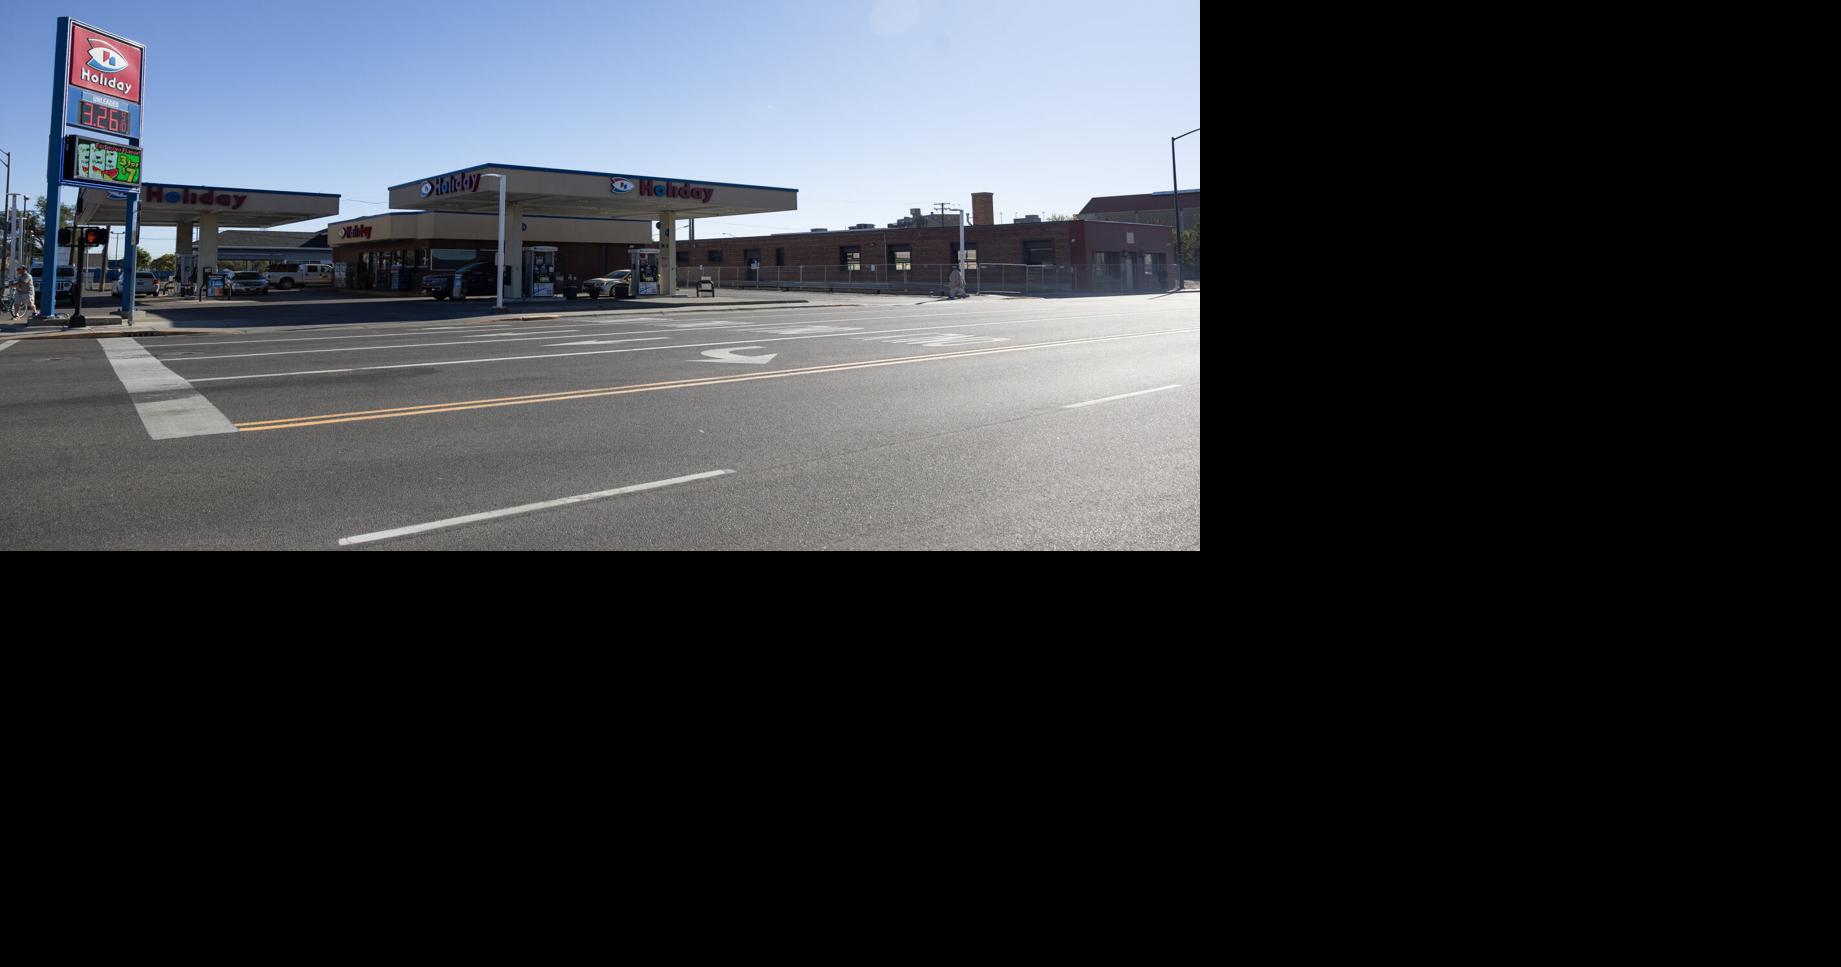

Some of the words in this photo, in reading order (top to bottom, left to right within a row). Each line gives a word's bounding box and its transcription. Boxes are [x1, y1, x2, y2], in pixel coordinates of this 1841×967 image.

[81, 67, 132, 94] Holiday
[120, 155, 127, 167] 3
[434, 172, 480, 195] Holiday
[639, 178, 714, 203] Holiday
[146, 185, 247, 209] Holiday
